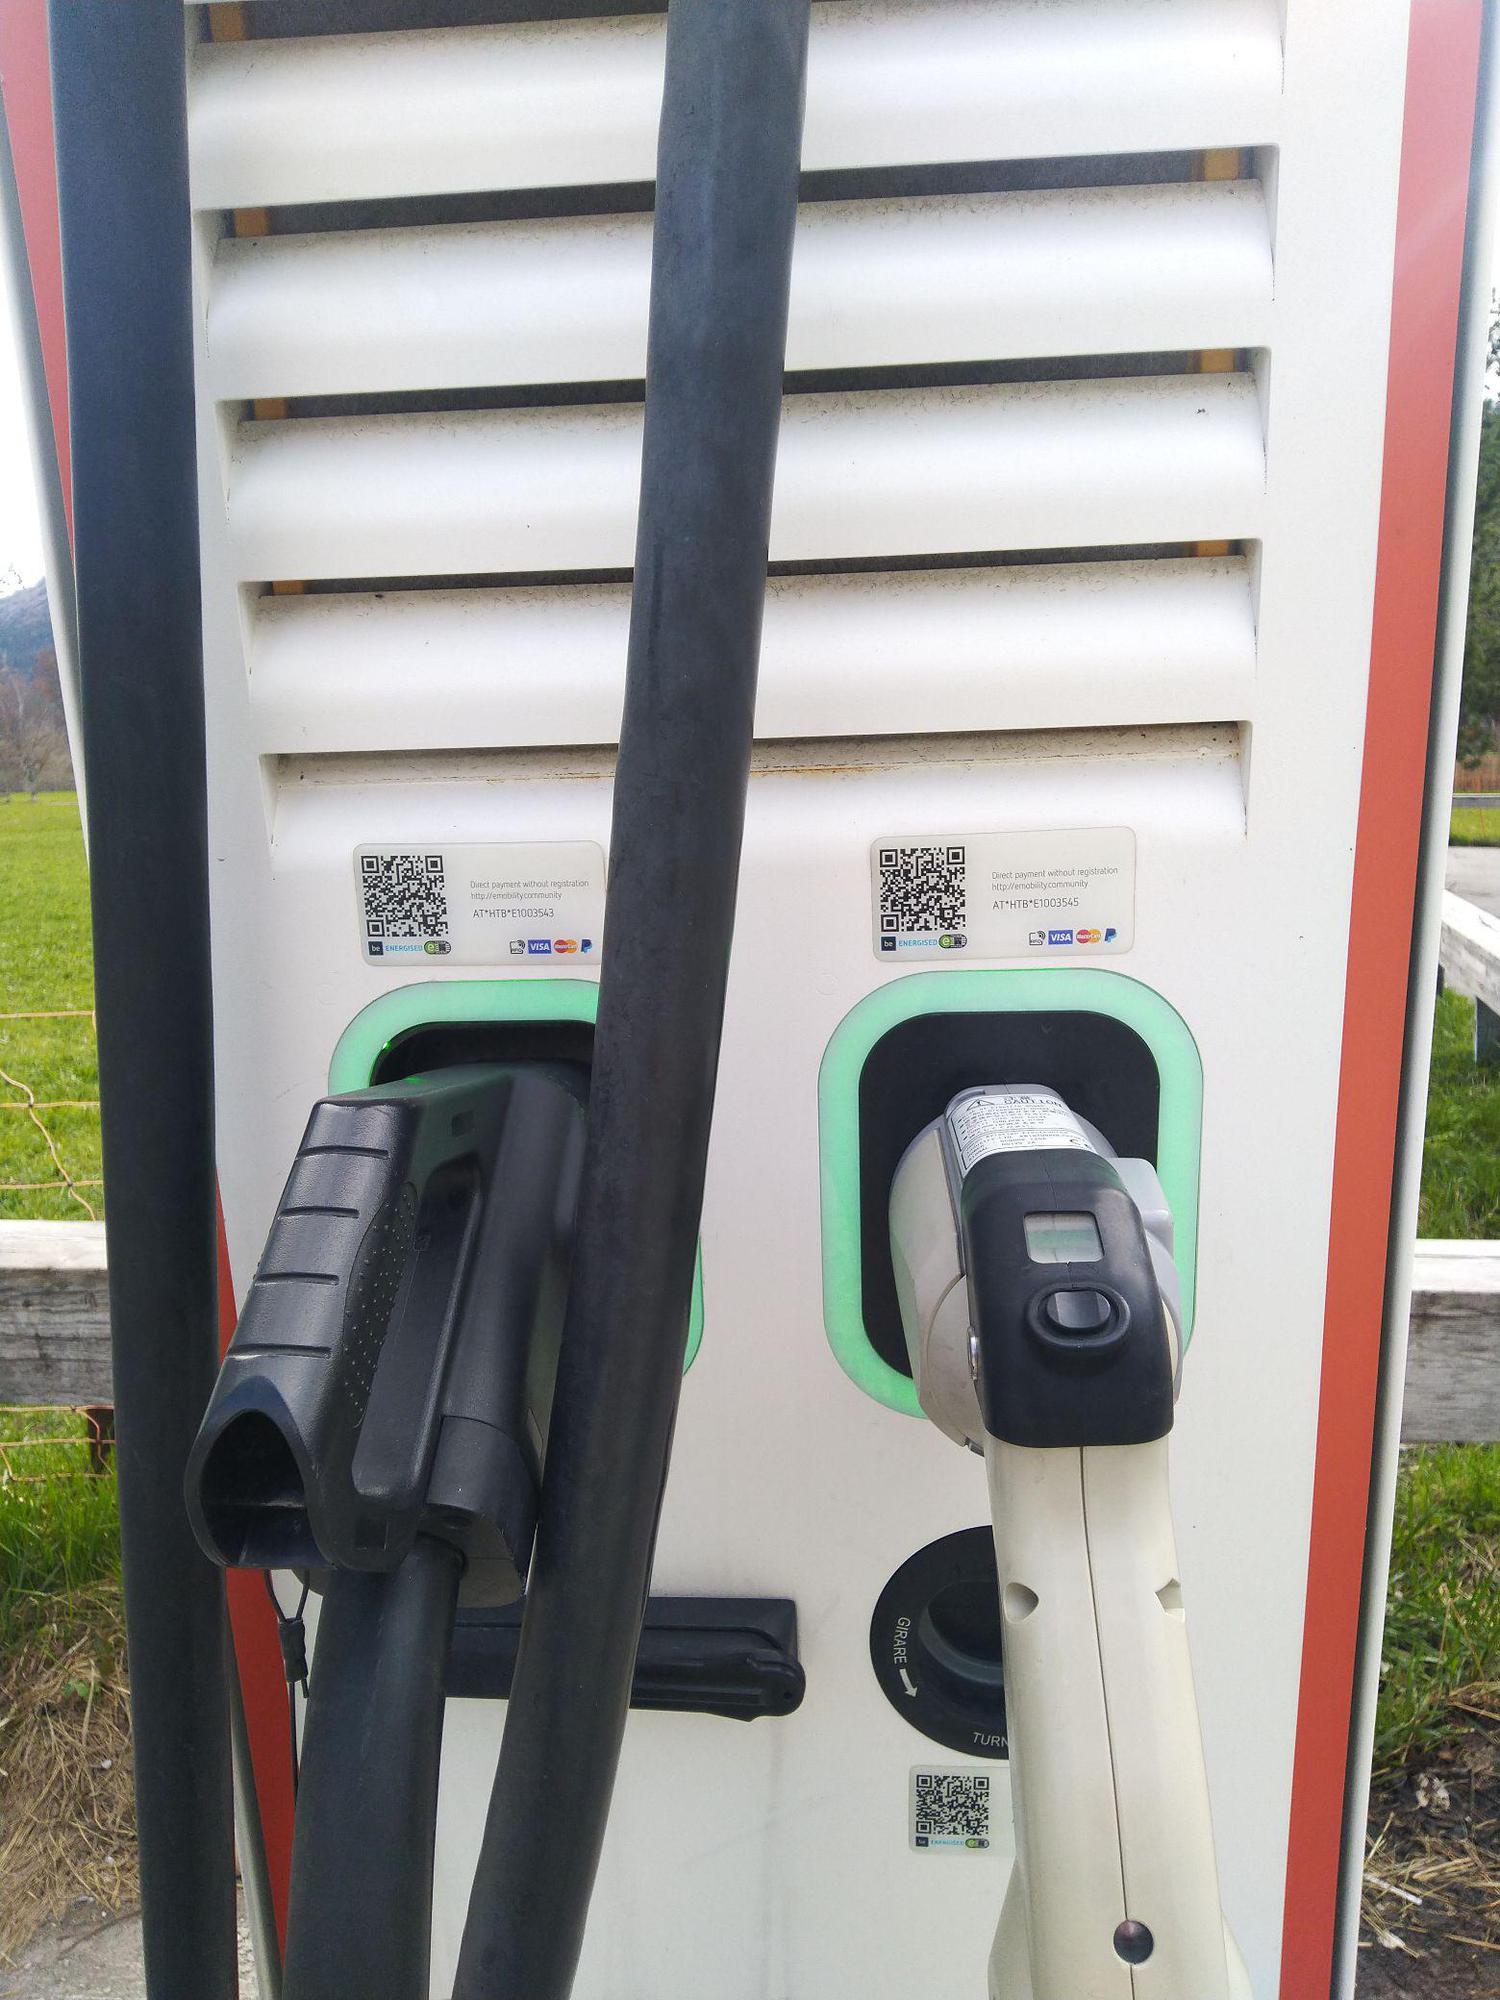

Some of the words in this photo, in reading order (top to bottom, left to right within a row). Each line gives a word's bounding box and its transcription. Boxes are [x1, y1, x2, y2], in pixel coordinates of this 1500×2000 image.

[991, 871, 1013, 880] Direct
[1015, 869, 1046, 880] payment
[1047, 868, 1075, 878] without
[1077, 866, 1118, 877] registration
[470, 880, 490, 889] Direct
[492, 880, 521, 890] payment
[523, 879, 549, 888] without
[551, 879, 589, 889] registration
[1050, 933, 1071, 941] VISA
[529, 943, 550, 951] VISA
[898, 938, 938, 947] ENERGISED
[893, 1616, 911, 1665] GIRARE
